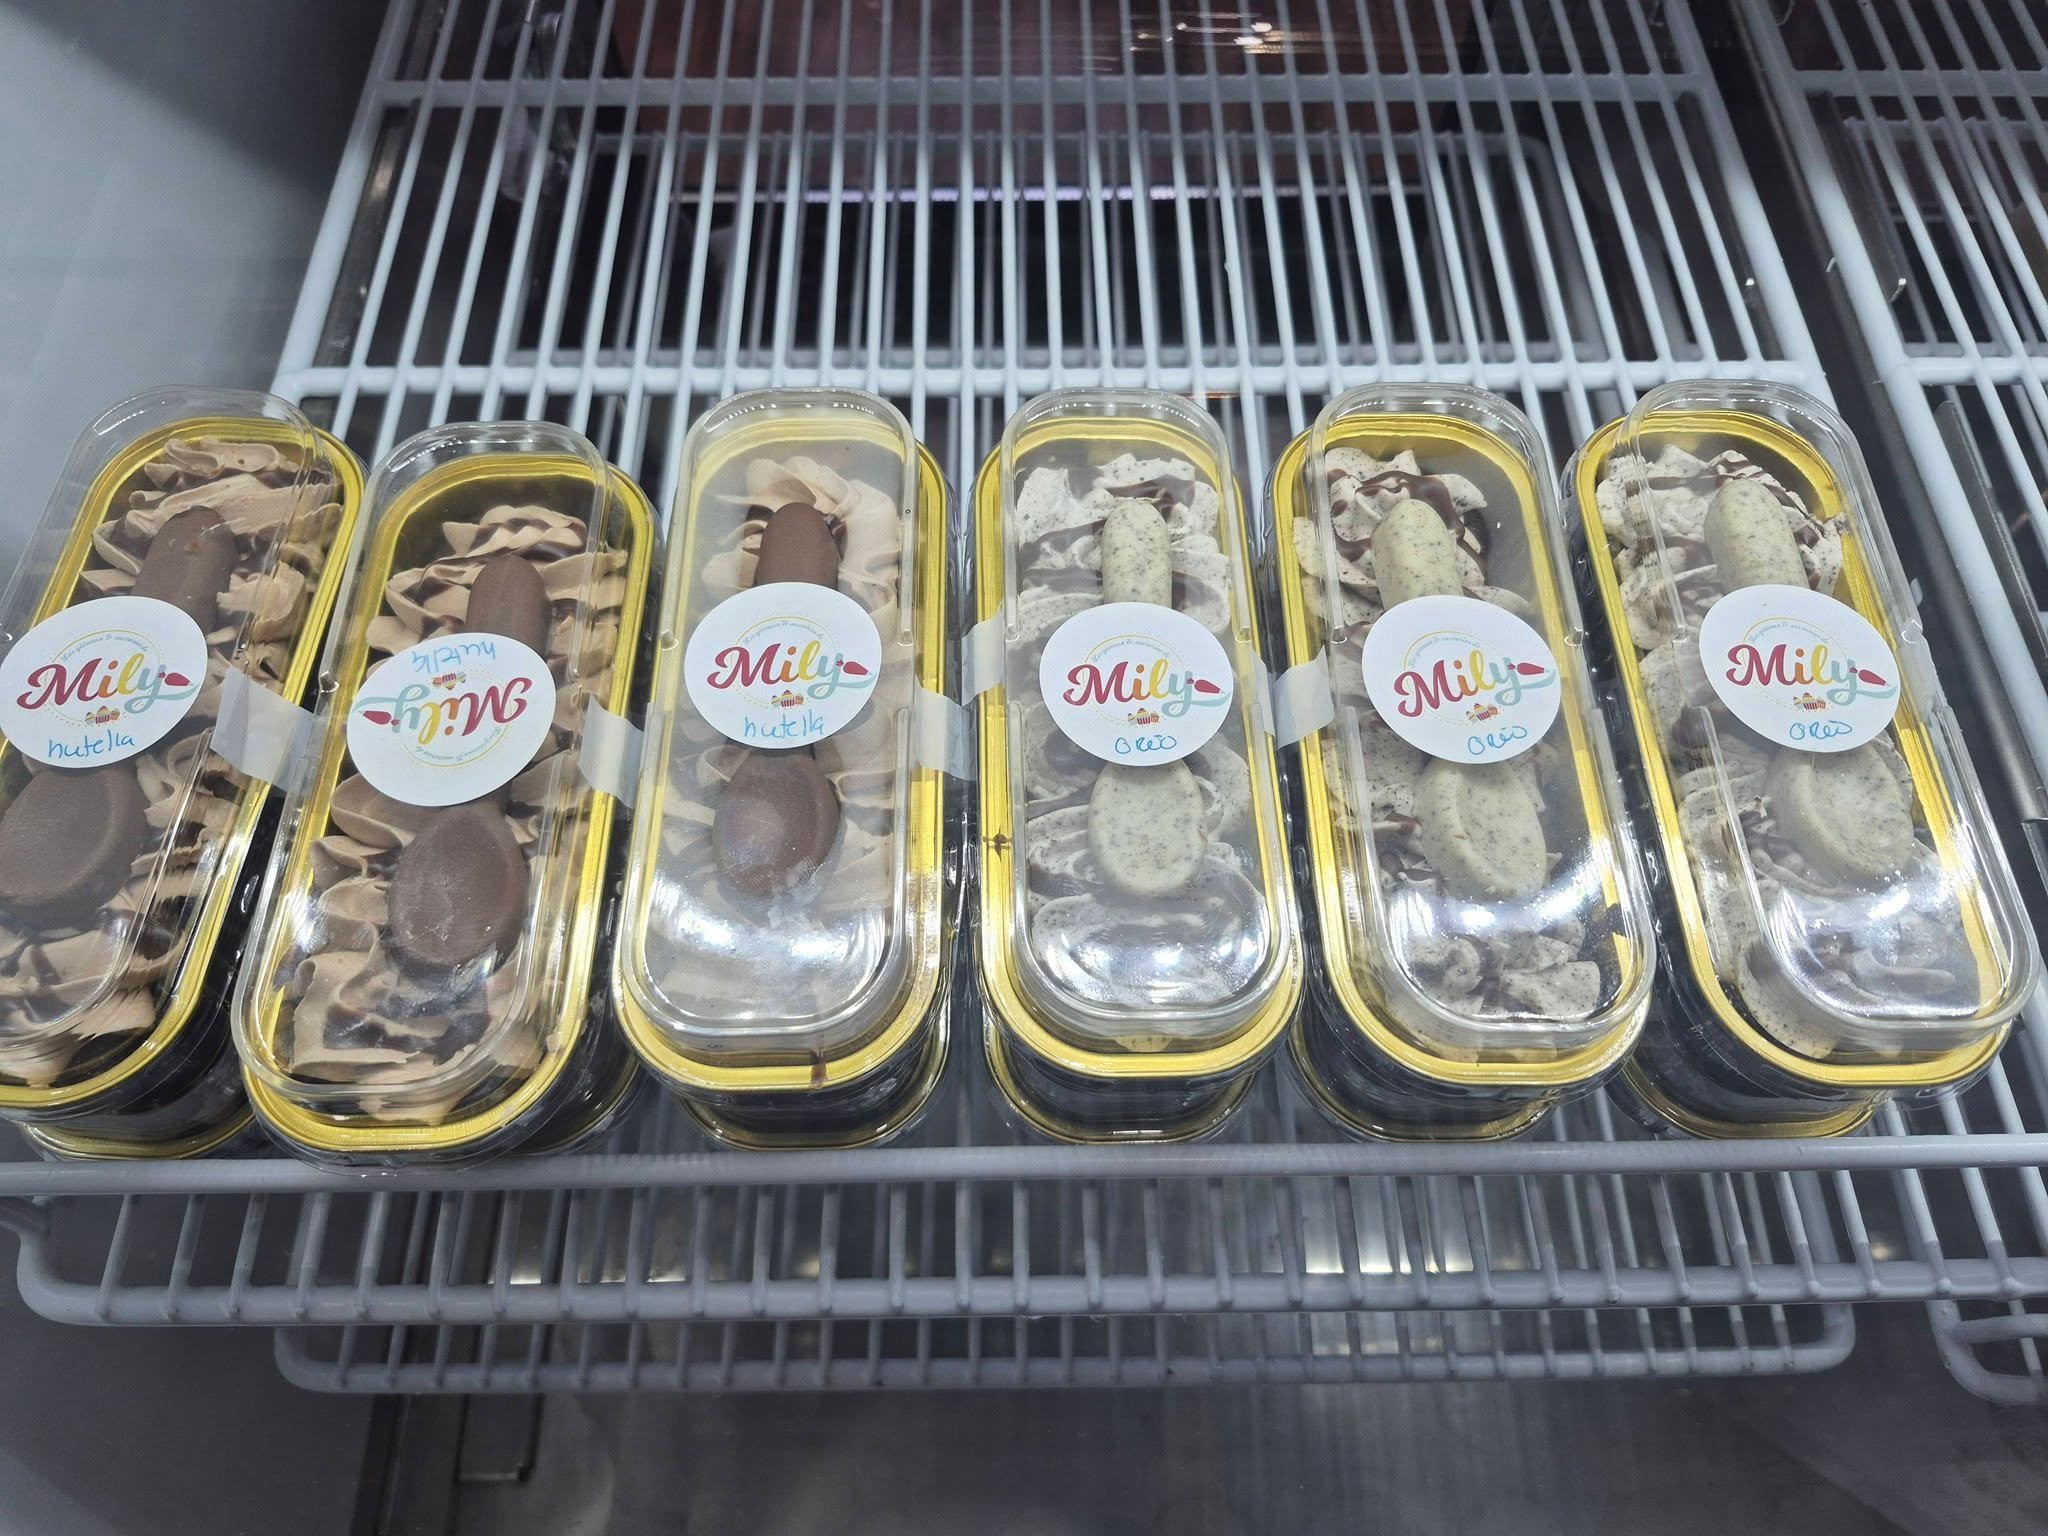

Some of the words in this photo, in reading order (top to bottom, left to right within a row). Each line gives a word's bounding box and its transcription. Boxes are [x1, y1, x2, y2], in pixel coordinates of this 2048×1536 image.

[17, 653, 199, 714] Mily
[707, 640, 877, 700] Mily
[1063, 658, 1231, 718] Mily
[1394, 650, 1556, 718] Mily
[1726, 644, 1897, 706] Mily
[352, 677, 533, 745] Mily
